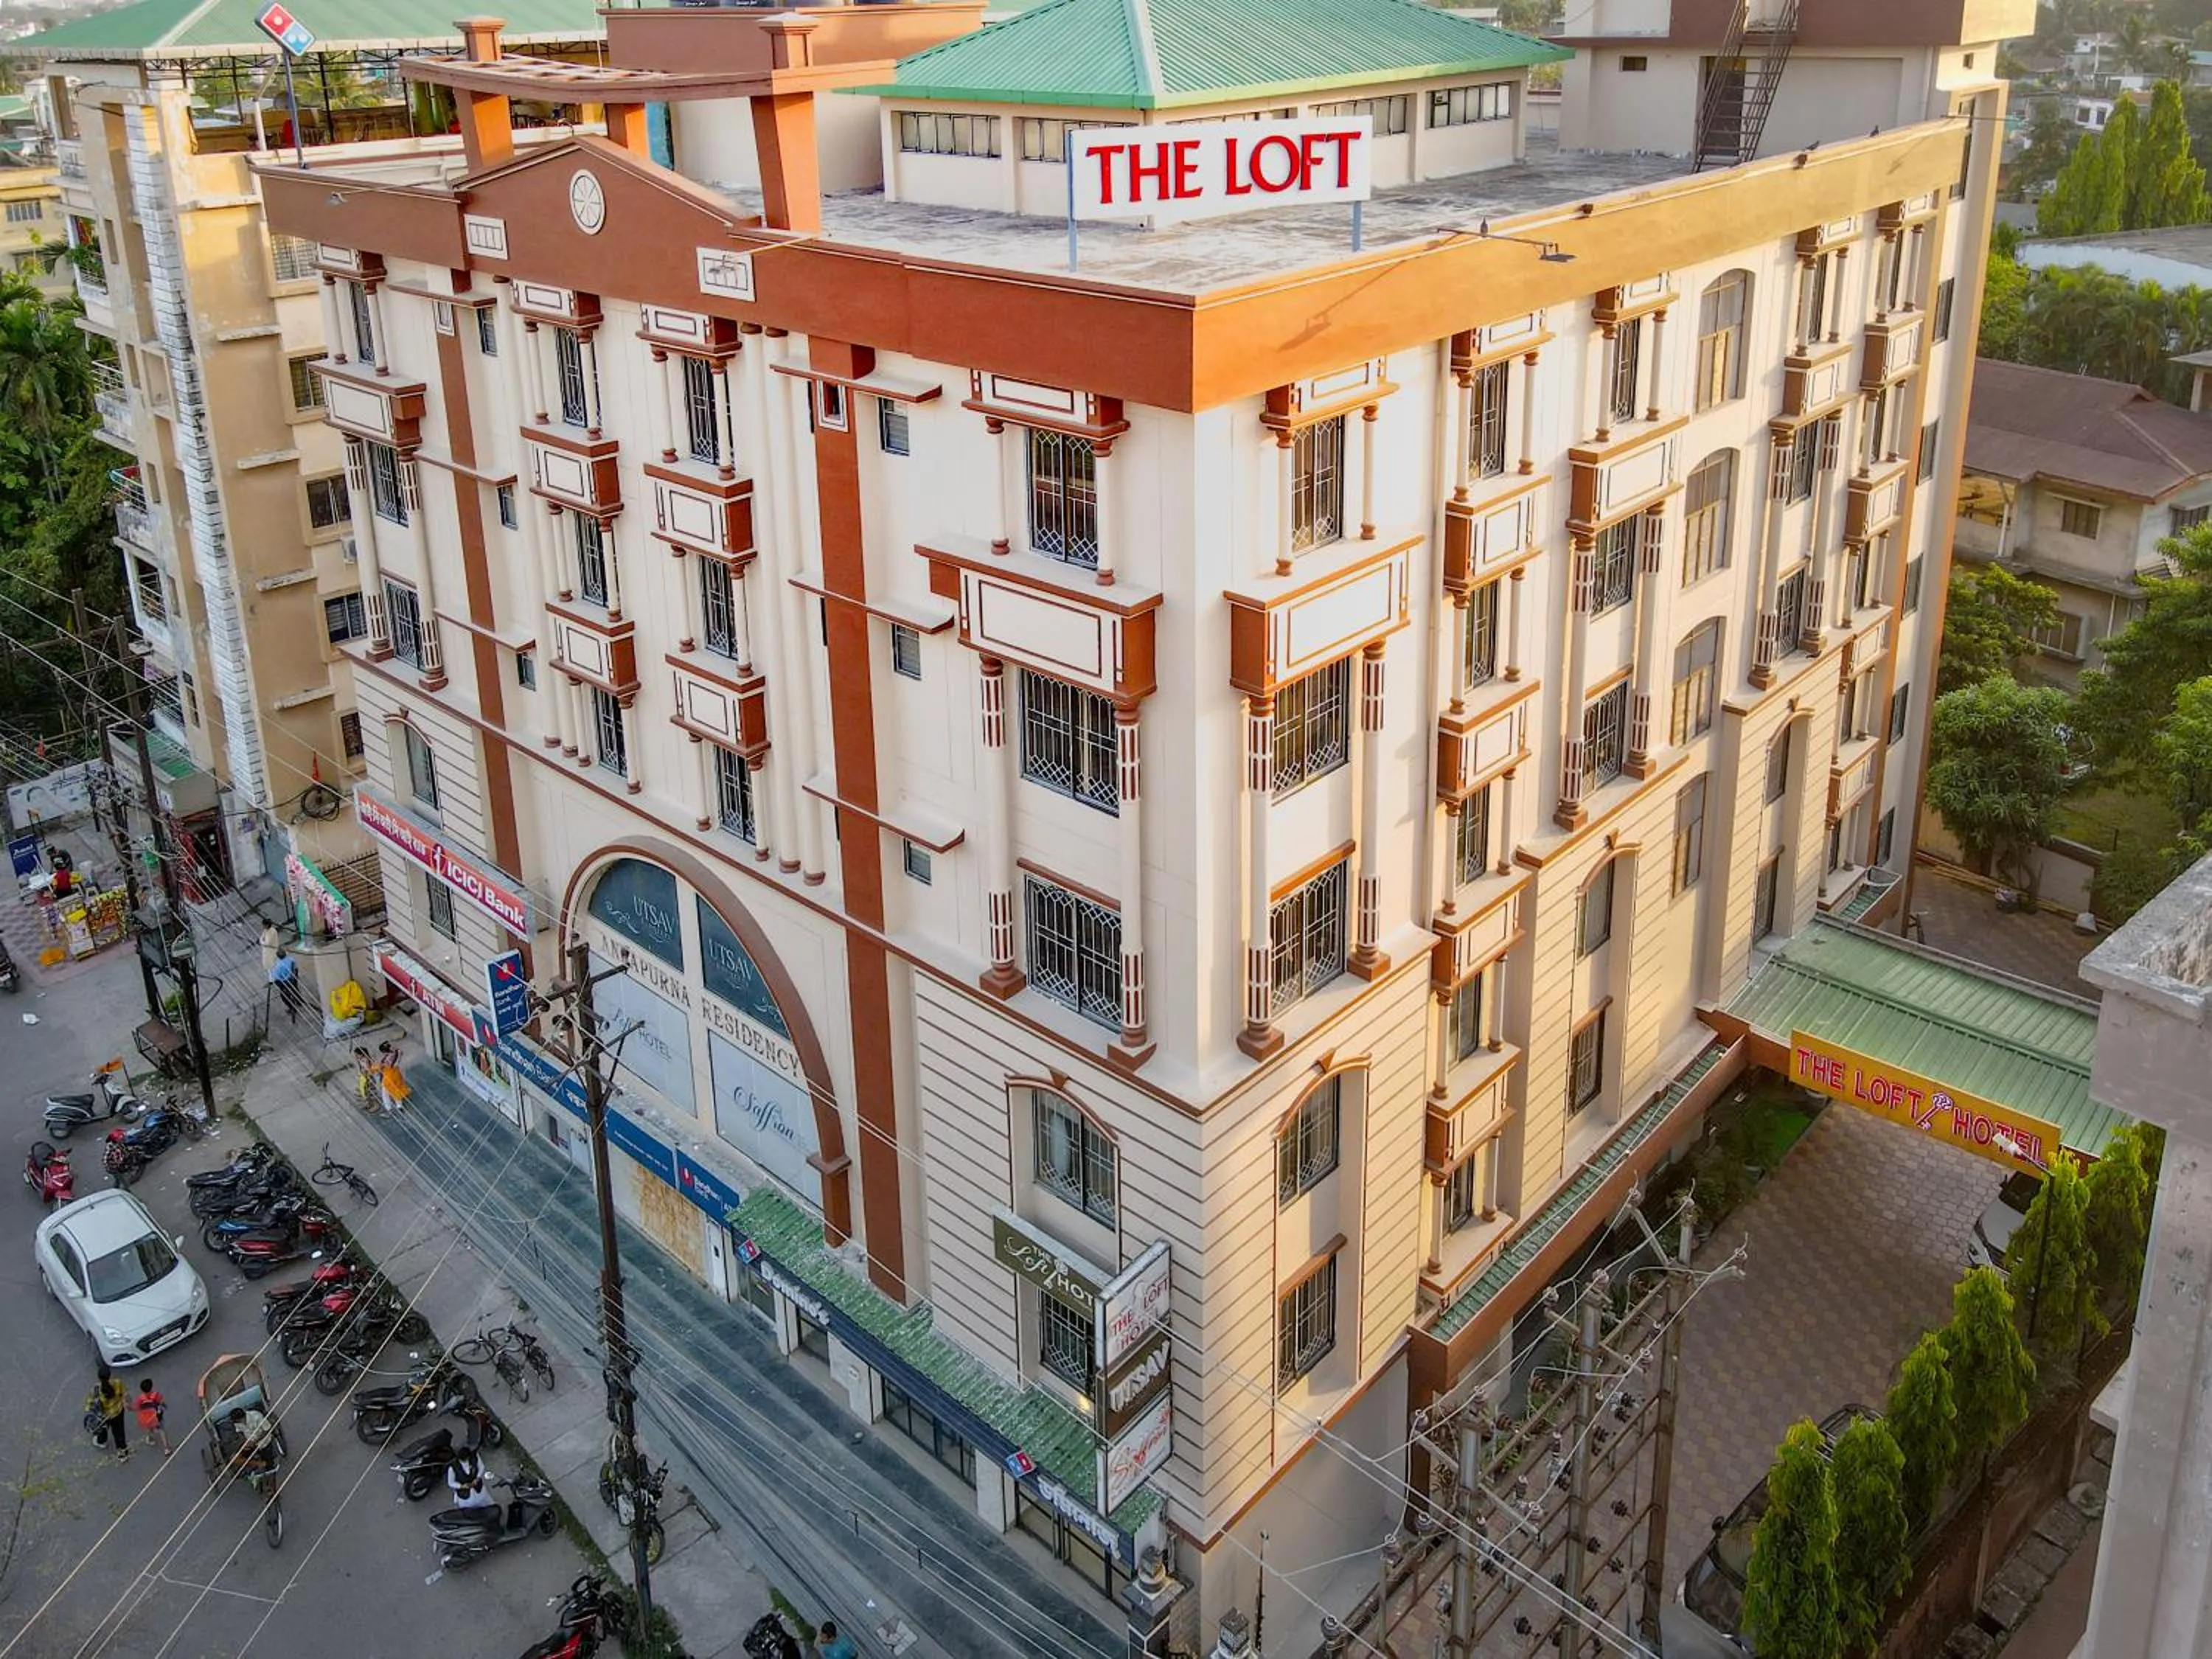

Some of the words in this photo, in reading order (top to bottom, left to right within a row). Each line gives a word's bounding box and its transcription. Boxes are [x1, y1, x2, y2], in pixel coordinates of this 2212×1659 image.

[1085, 139, 1203, 204] THE
[1225, 131, 1362, 195] LOFT
[485, 885, 524, 929] Bank
[633, 894, 675, 934] UTSAV
[708, 938, 754, 981] UTSAV
[422, 988, 446, 1018] ATM
[701, 996, 799, 1078] RESIDENCY
[733, 1085, 795, 1141] Saffron
[1797, 1048, 1845, 1090] THE
[1854, 1070, 1924, 1119] LOFT
[1952, 1107, 2048, 1168] HOTEL
[1003, 1237, 1048, 1276] Loft
[1032, 1245, 1052, 1263] THE
[1057, 1275, 1093, 1307] HOT
[1111, 1308, 1134, 1335] THE
[1143, 1277, 1168, 1309] LOFT
